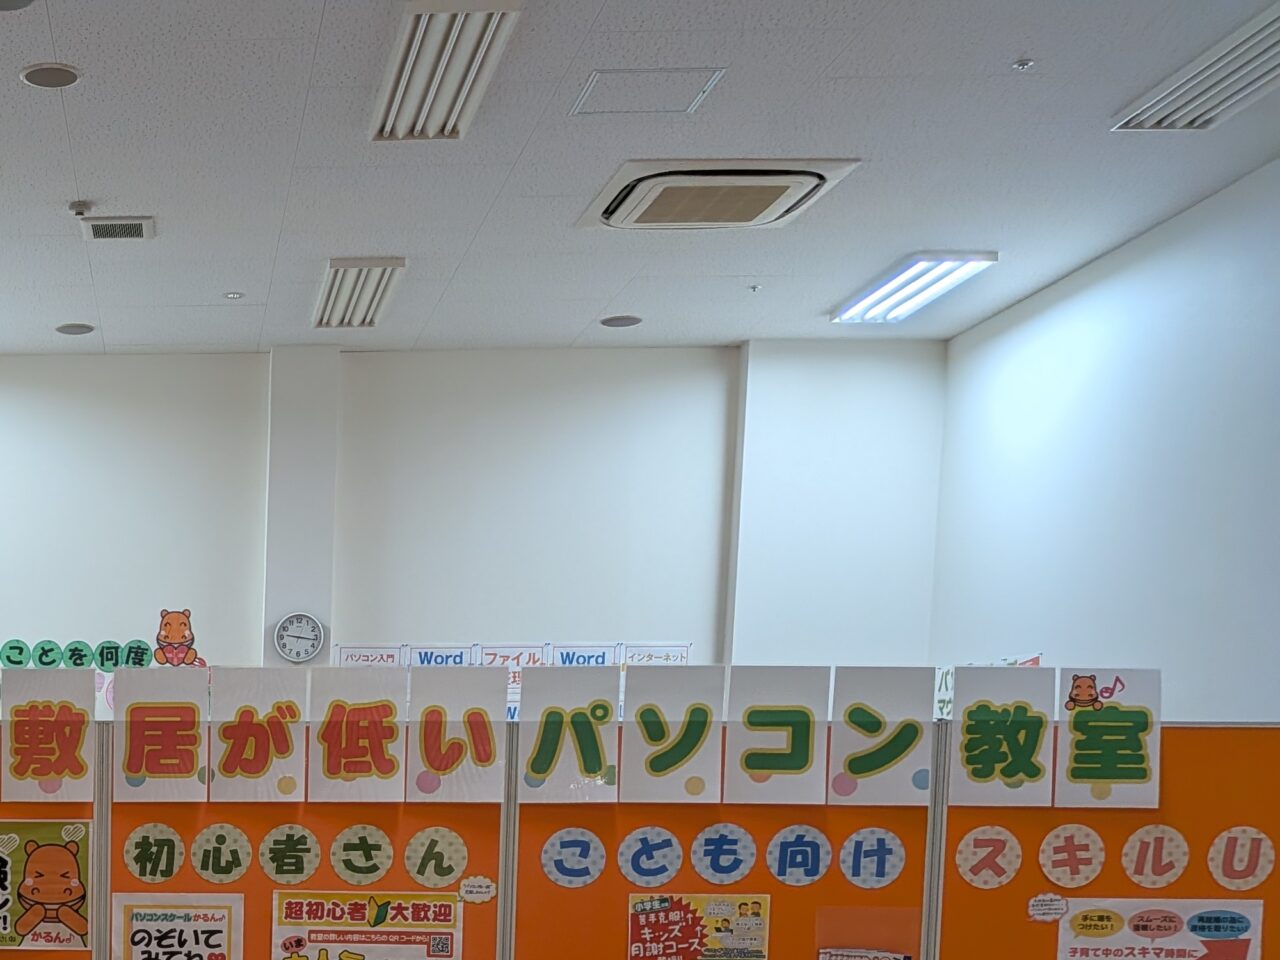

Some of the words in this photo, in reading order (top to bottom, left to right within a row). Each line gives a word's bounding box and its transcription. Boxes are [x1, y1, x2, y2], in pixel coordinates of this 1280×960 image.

[345, 653, 395, 663] パソコン入門
[418, 651, 463, 665] Word
[485, 651, 540, 665] ファイル
[560, 651, 606, 665] Word
[133, 833, 457, 878] 初心者さん
[554, 833, 893, 878] こども向け
[283, 900, 368, 922] 超初心者
[389, 902, 453, 923] 大歓迎
[1137, 915, 1177, 923] スムーズに
[31, 931, 66, 944] かるん
[130, 928, 223, 948] のぞいて
[641, 922, 686, 941] キッズ
[283, 940, 305, 950] いま
[631, 938, 701, 957] 月謝コース
[1069, 946, 1198, 959] 子育て中のスキマ時間に
